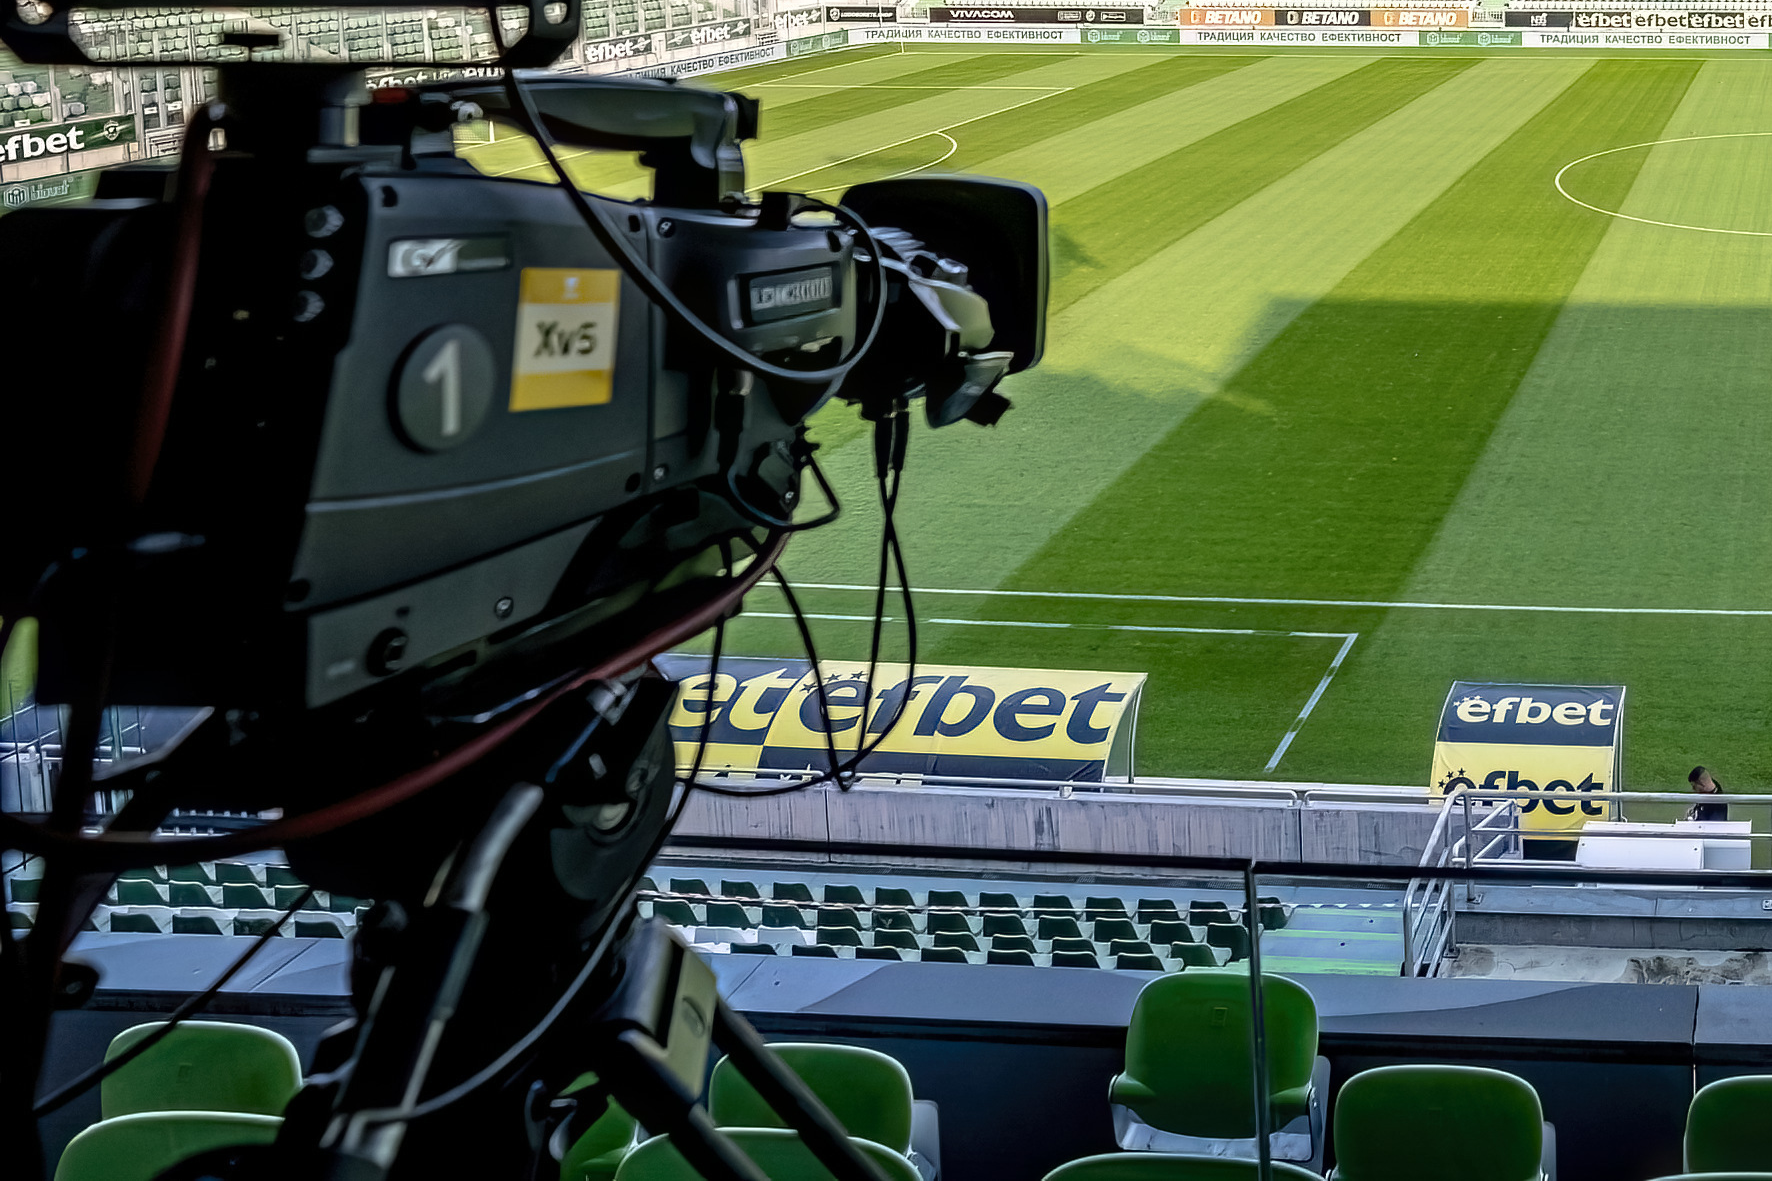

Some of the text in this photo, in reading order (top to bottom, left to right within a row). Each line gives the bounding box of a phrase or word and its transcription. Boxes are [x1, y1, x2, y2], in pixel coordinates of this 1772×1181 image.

[949, 10, 1015, 19] VIVACOM
[1205, 11, 1262, 25] BETANO
[1301, 11, 1359, 25] BETANO
[1399, 12, 1457, 26] BETANO
[1577, 12, 1632, 27] efbet
[1635, 13, 1687, 28] efbet
[1689, 12, 1745, 27] efbet
[866, 30, 1064, 39] ТРАДИЦИЯ КАЧЕСТВО ЕФЕКТИВНОСТ
[1197, 31, 1402, 43] ТРАДИЦИЯ КАЧЕСТВО ЕФЕКТИВНОСТ
[1540, 34, 1751, 45] ТРАДИЦИЯ КАЧЕСТВО ЕФЕКТИВНОСТ
[670, 58, 715, 76] КАЧЕСТВО
[718, 46, 775, 66] ЕФЕКТИВНОСТ
[0, 126, 85, 161] fbet
[422, 338, 462, 437] 1
[799, 672, 1127, 745] efbet
[1453, 695, 1613, 726] efbet
[1438, 769, 1604, 816] efbet
